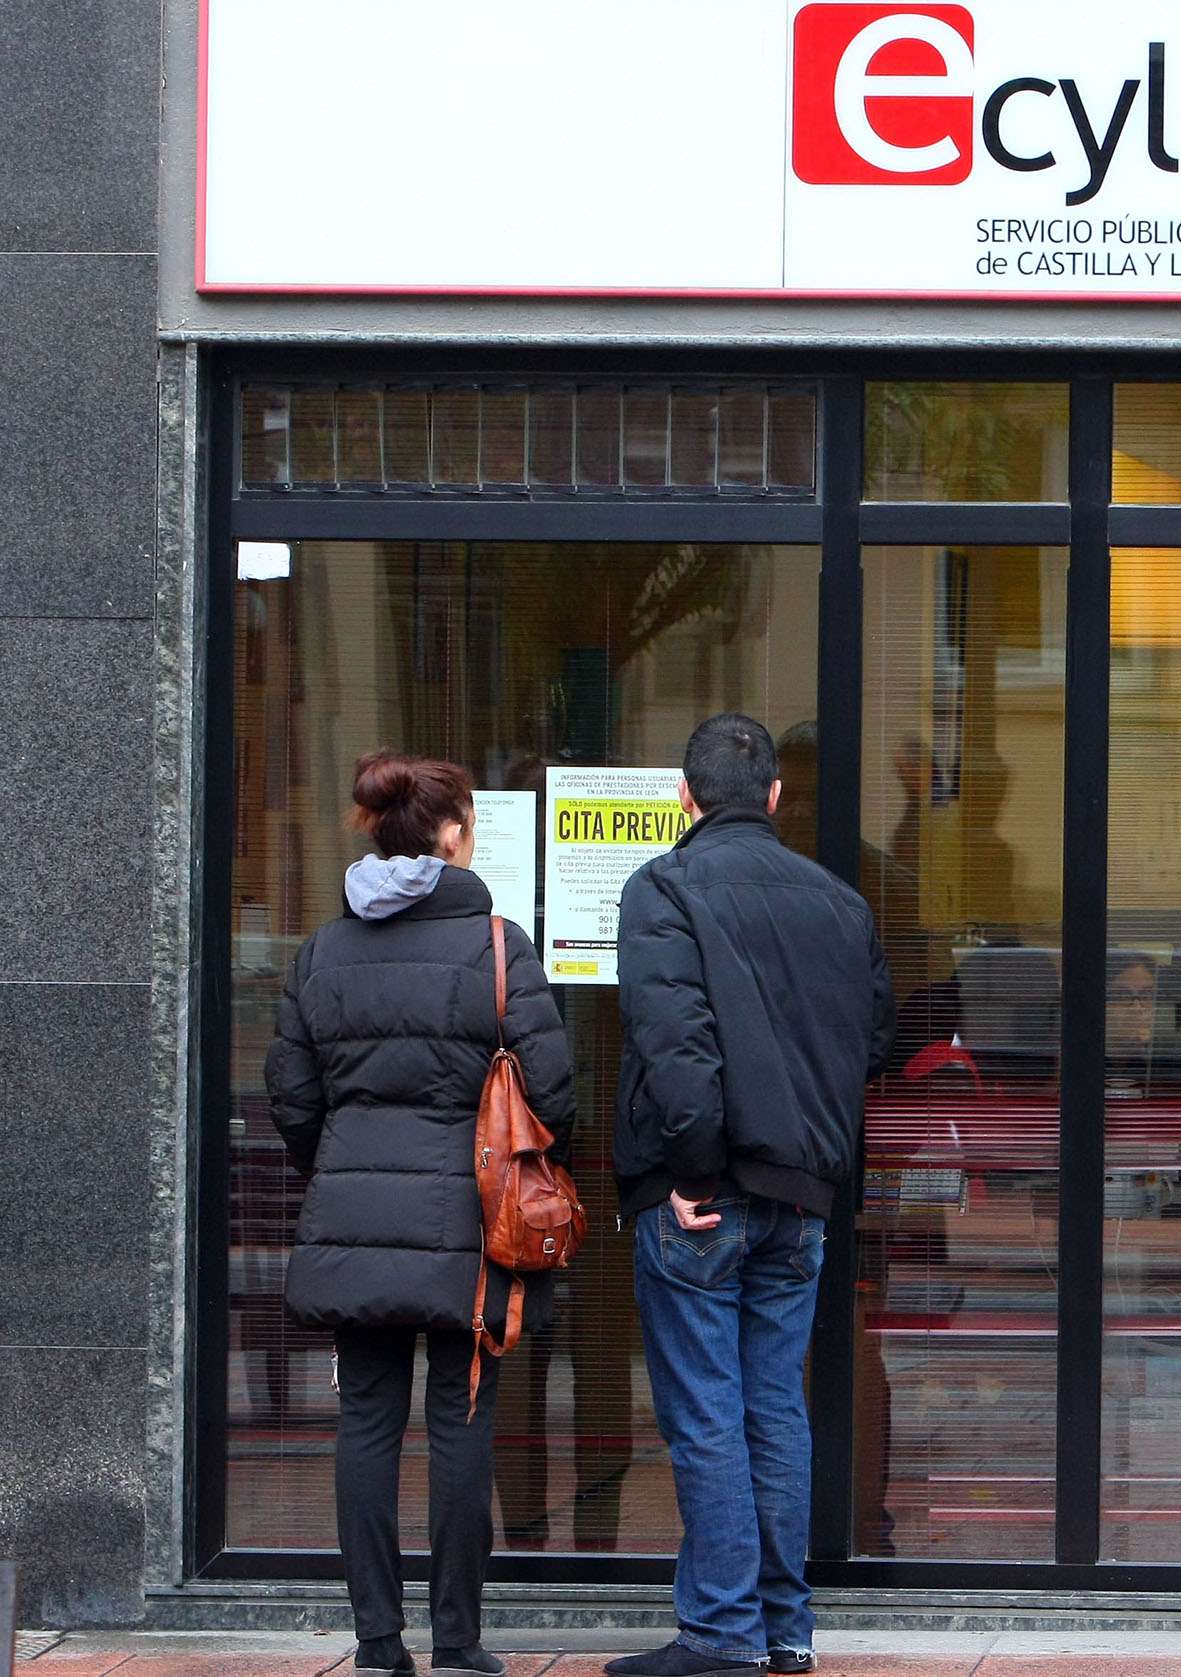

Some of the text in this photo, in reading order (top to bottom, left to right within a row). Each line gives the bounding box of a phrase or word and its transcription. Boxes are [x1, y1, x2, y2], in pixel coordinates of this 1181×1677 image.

[834, 13, 1179, 206] ecyl
[976, 220, 1092, 245] SERVICIO
[976, 252, 1008, 276] de
[1017, 252, 1138, 277] CASTILLA
[1144, 253, 1162, 277] Y
[559, 810, 688, 842] CITA PREVIA
